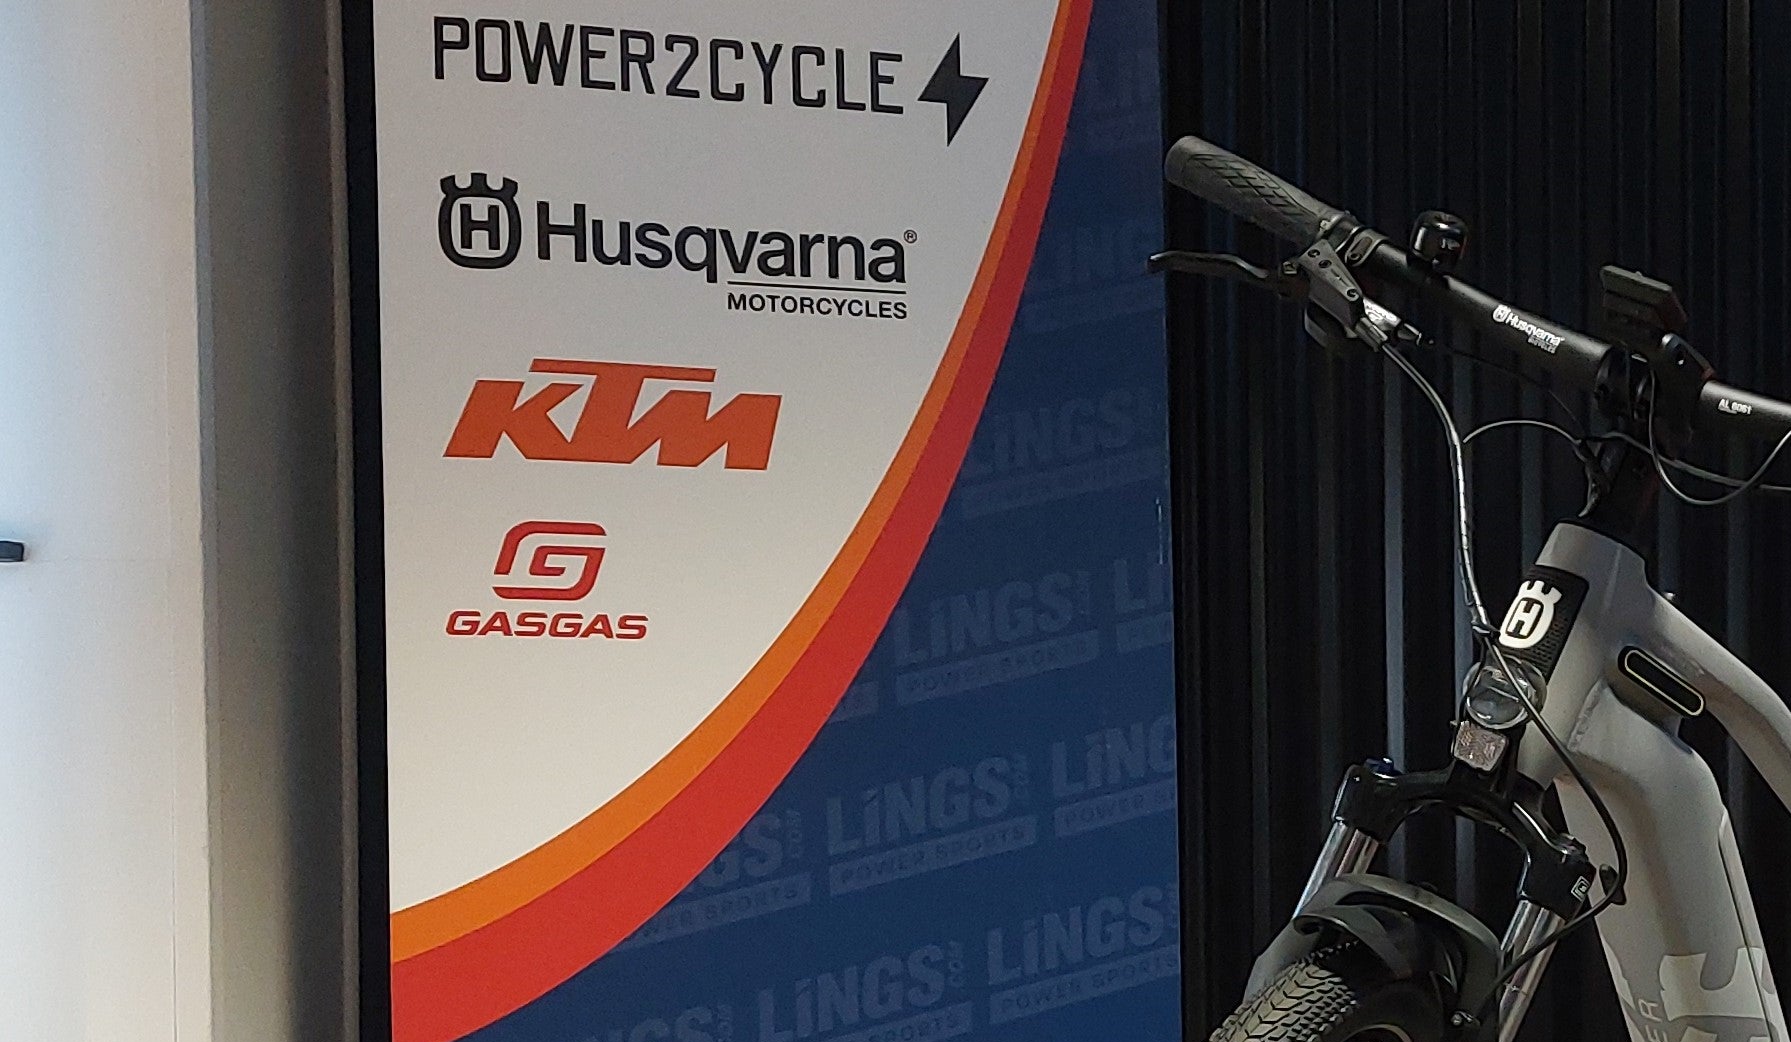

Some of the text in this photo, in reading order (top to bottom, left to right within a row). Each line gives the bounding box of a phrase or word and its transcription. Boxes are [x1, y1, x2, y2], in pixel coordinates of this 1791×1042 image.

[433, 16, 905, 114] POWER2CYCLE
[727, 292, 908, 320] MOTORCYCLES
[443, 358, 782, 471] KTM
[445, 611, 648, 640] GASGAS
